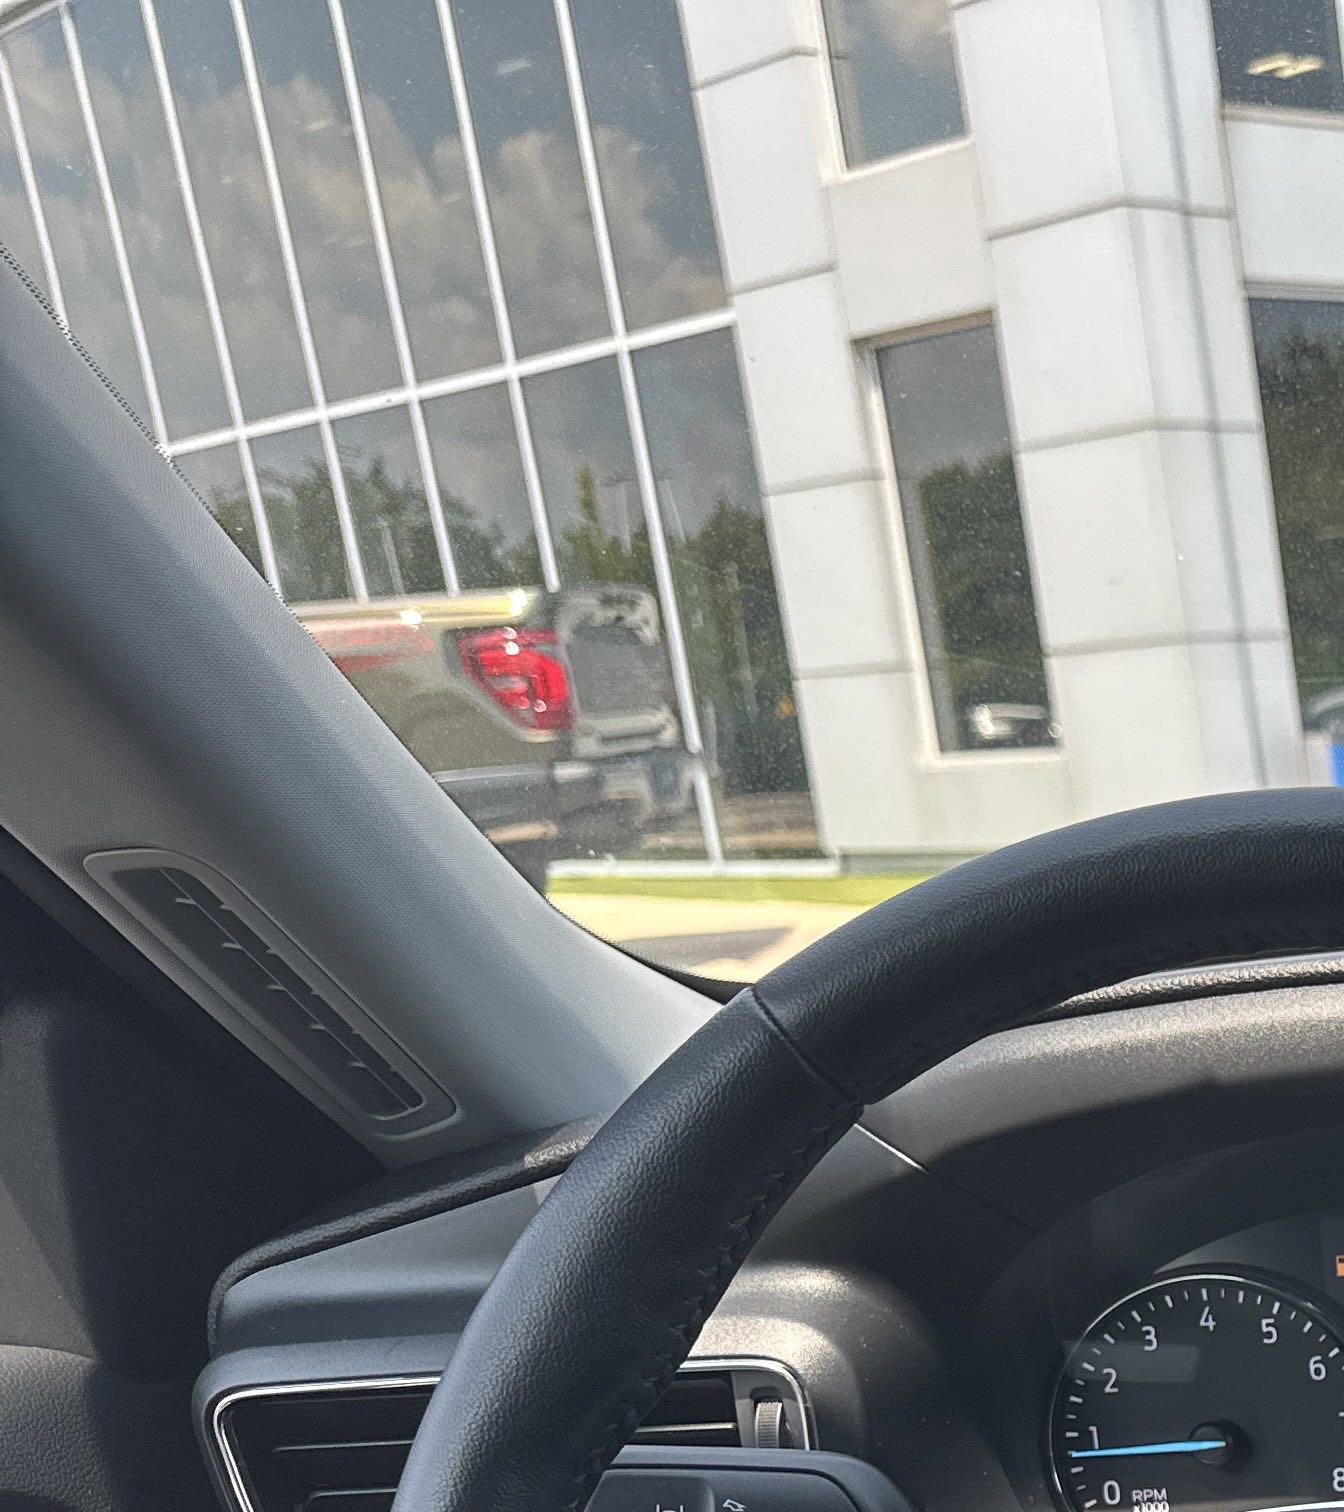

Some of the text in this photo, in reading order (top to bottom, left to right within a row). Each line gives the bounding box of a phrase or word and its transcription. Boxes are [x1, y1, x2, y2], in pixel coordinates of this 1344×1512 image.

[1200, 1306, 1217, 1332] 4
[1261, 1318, 1278, 1345] 5
[1141, 1325, 1158, 1352] 3
[1102, 1368, 1120, 1394] 2
[1308, 1355, 1327, 1382] 6
[1088, 1425, 1100, 1451] 1
[1102, 1480, 1122, 1506] 0
[1132, 1488, 1168, 1502] RPM
